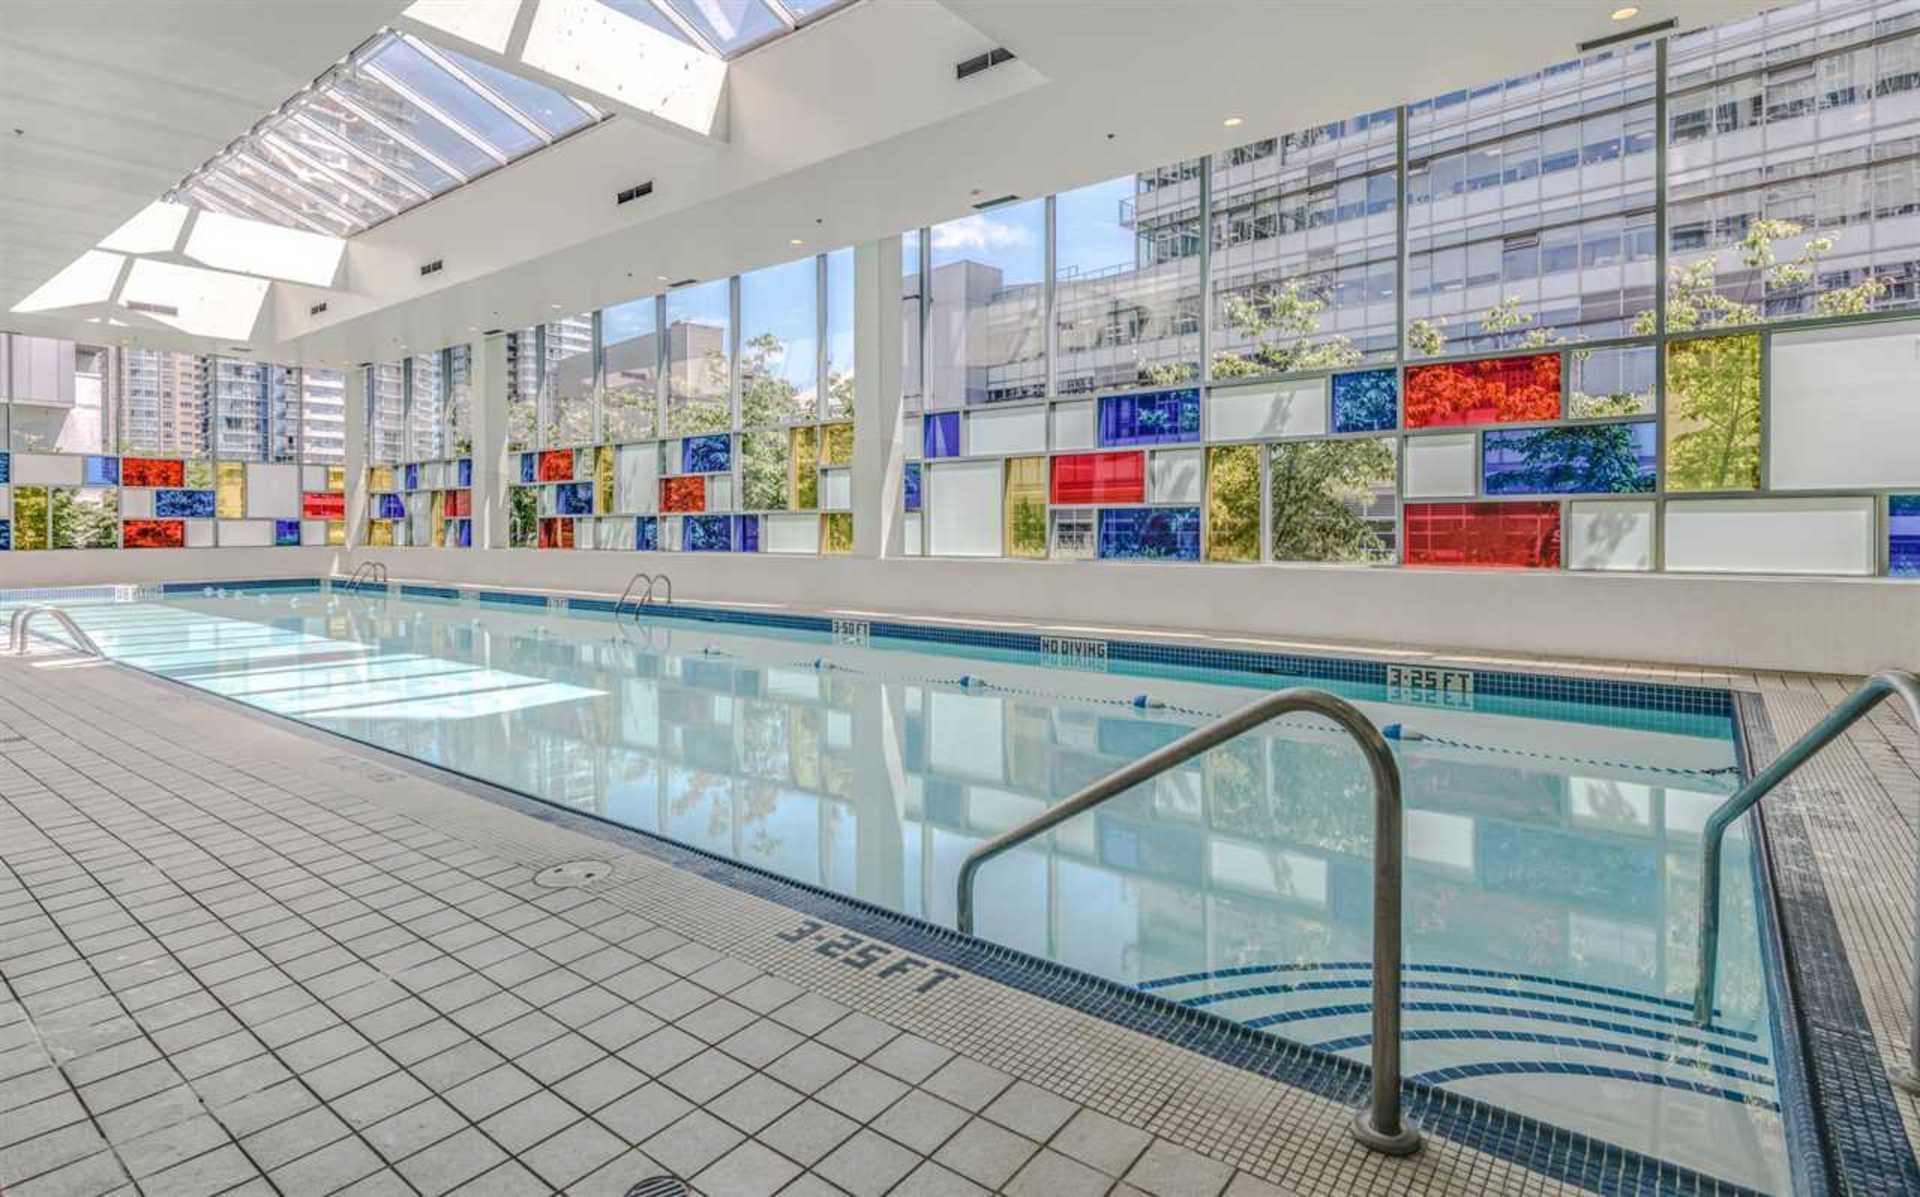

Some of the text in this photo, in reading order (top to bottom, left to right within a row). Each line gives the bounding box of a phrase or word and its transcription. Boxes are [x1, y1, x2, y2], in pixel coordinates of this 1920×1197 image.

[1042, 640, 1105, 657] NO DIVING
[1443, 671, 1470, 690] FT
[878, 957, 960, 993] FT
